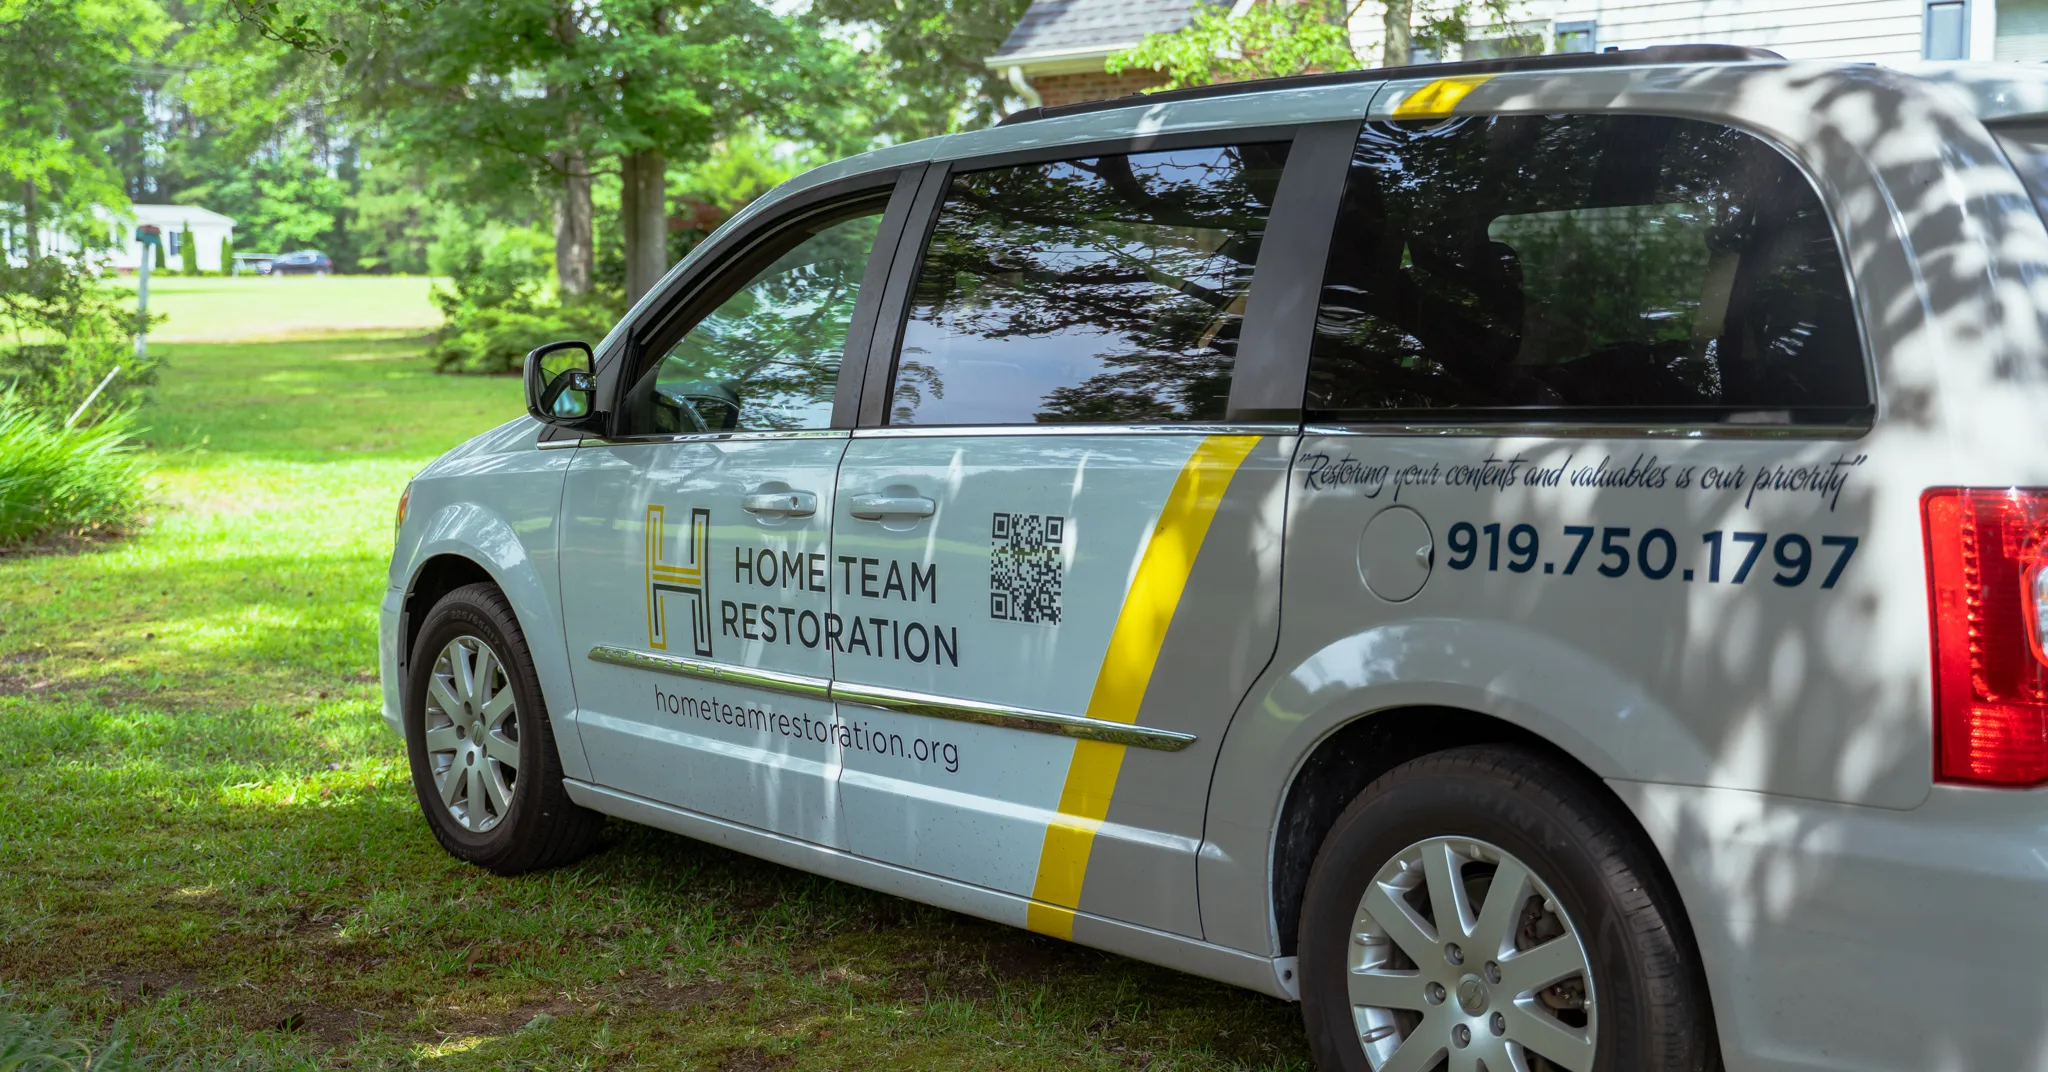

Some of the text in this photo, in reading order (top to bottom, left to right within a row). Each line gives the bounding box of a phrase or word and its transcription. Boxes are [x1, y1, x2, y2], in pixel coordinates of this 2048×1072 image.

[1393, 463, 1442, 503] your
[1445, 453, 1529, 492] contents
[1523, 454, 1573, 488] and
[1570, 453, 1671, 489] valuables
[1675, 464, 1697, 489] is
[1700, 464, 1748, 491] our
[735, 546, 937, 604] HOME TEAM
[1446, 521, 1860, 590] 919.750.1797
[604, 648, 723, 677] CHRYSLER
[721, 600, 959, 667] RESTORATION
[654, 683, 960, 773] hometeamrestoration.org
